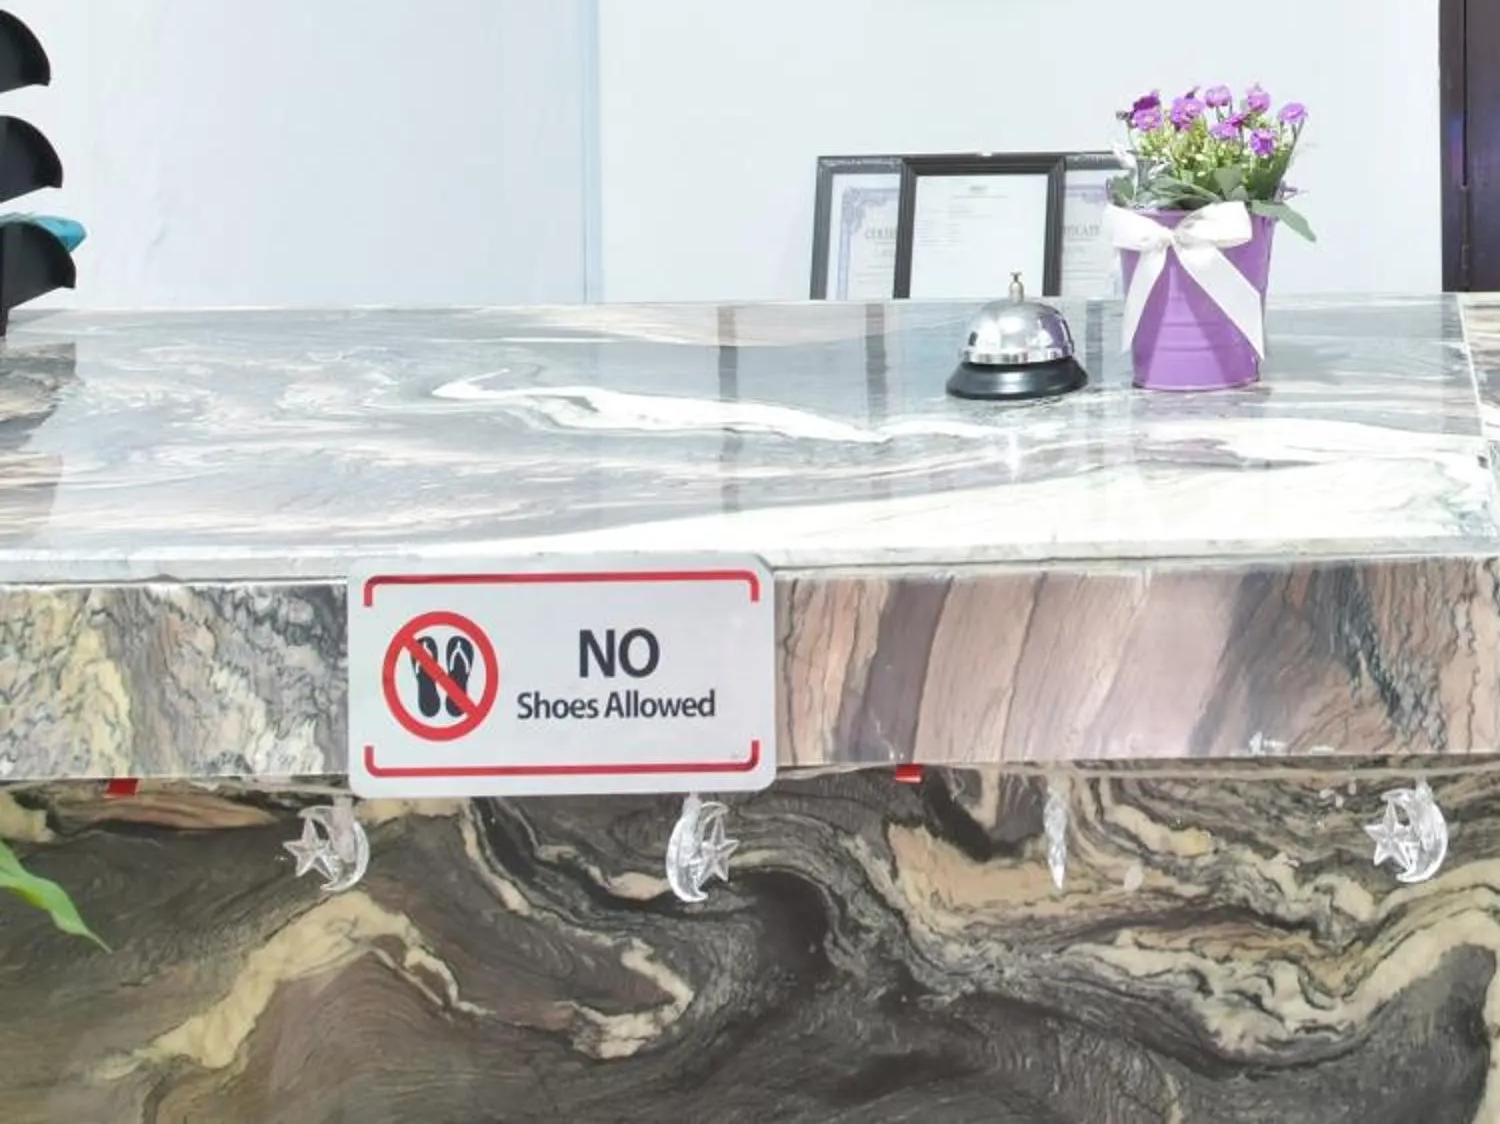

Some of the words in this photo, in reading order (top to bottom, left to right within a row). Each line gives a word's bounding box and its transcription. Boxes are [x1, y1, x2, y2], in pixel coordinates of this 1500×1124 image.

[579, 628, 660, 678] NO
[517, 691, 599, 720] Shoes
[604, 689, 716, 719] Allowed
